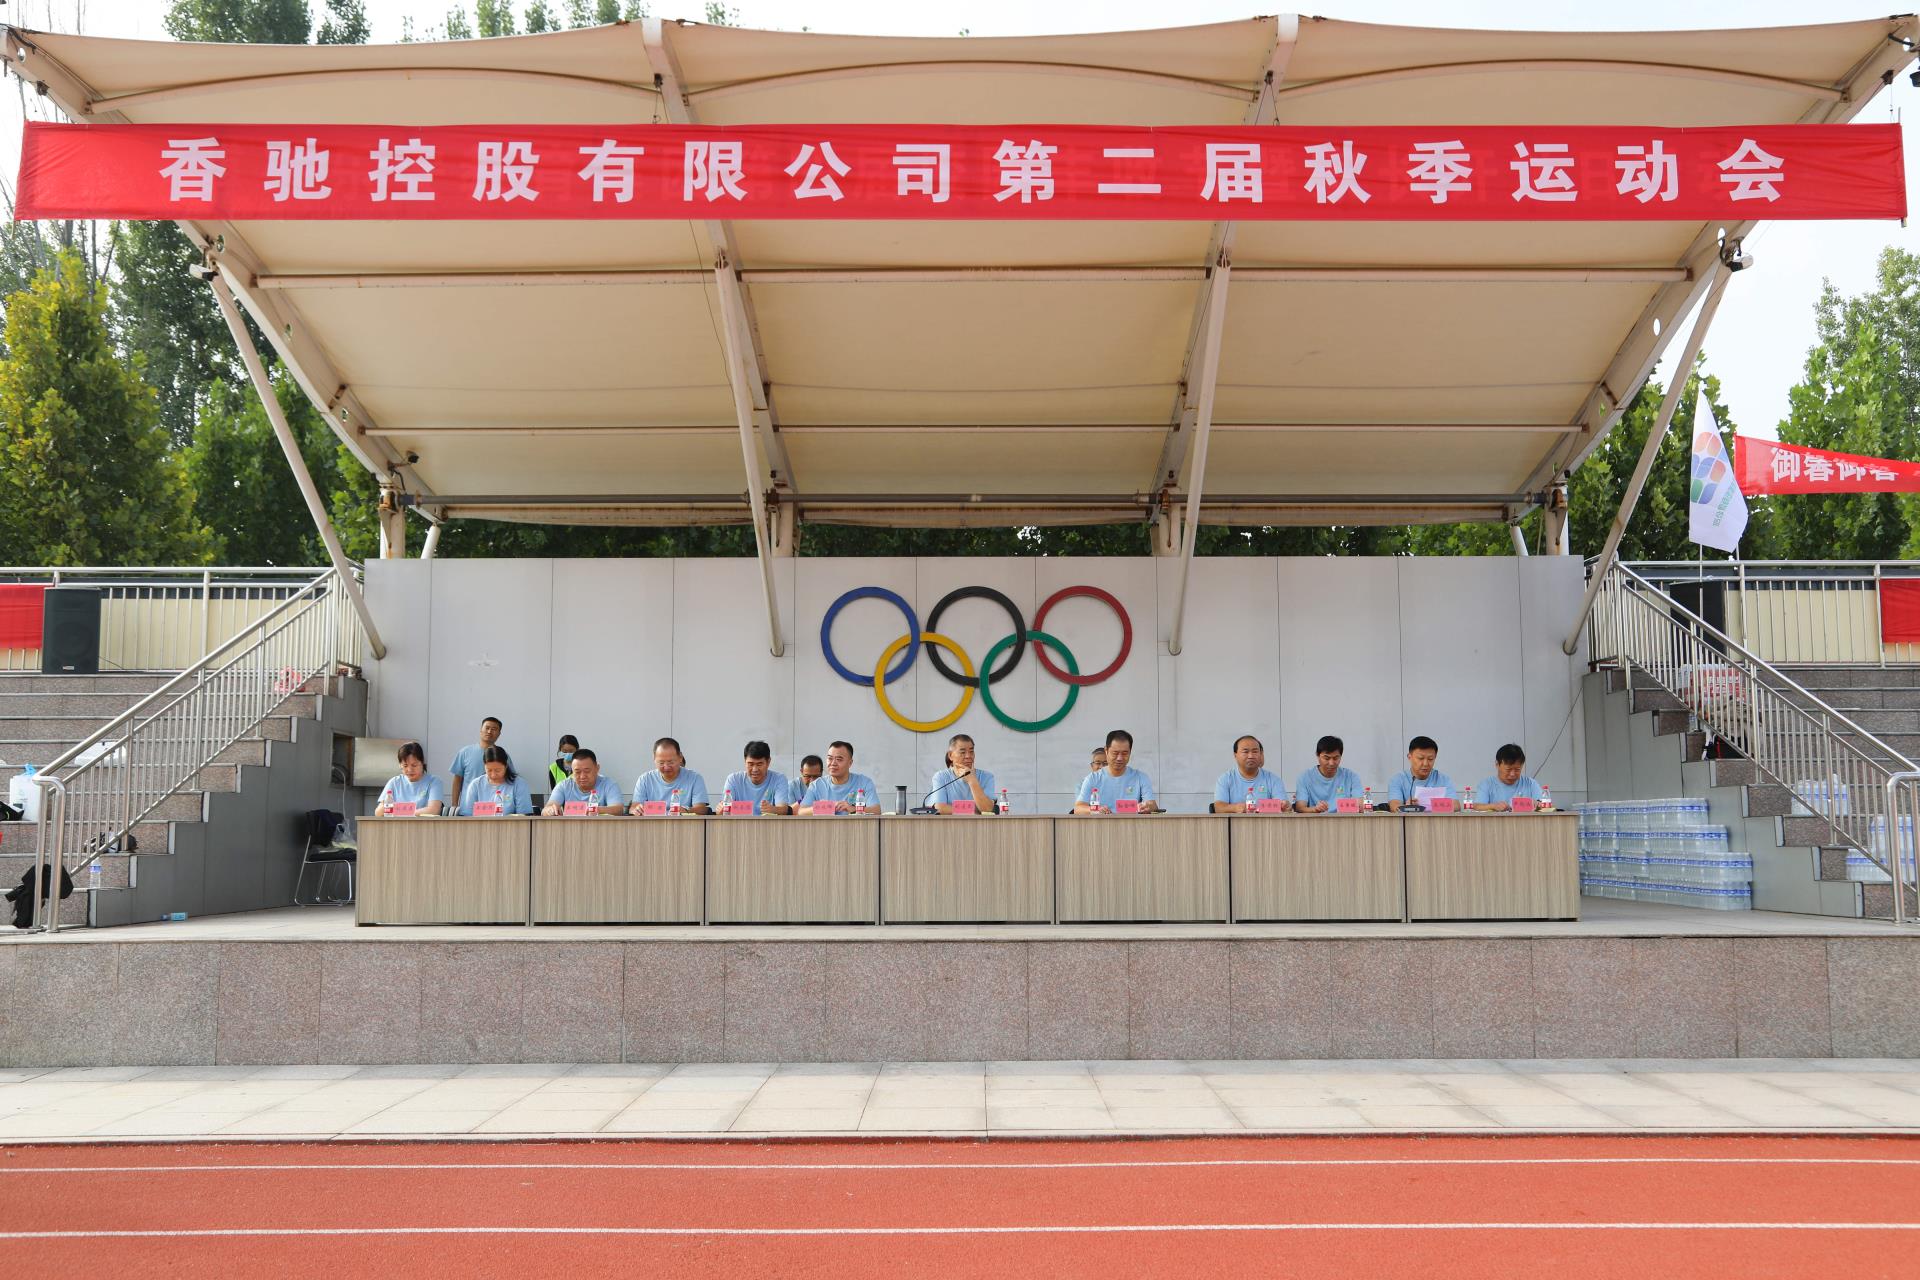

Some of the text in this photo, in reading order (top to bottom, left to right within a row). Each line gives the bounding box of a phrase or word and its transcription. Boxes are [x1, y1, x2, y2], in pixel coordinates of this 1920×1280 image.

[159, 138, 1785, 204] 香驰控股有限公司第二届秋季运动会
